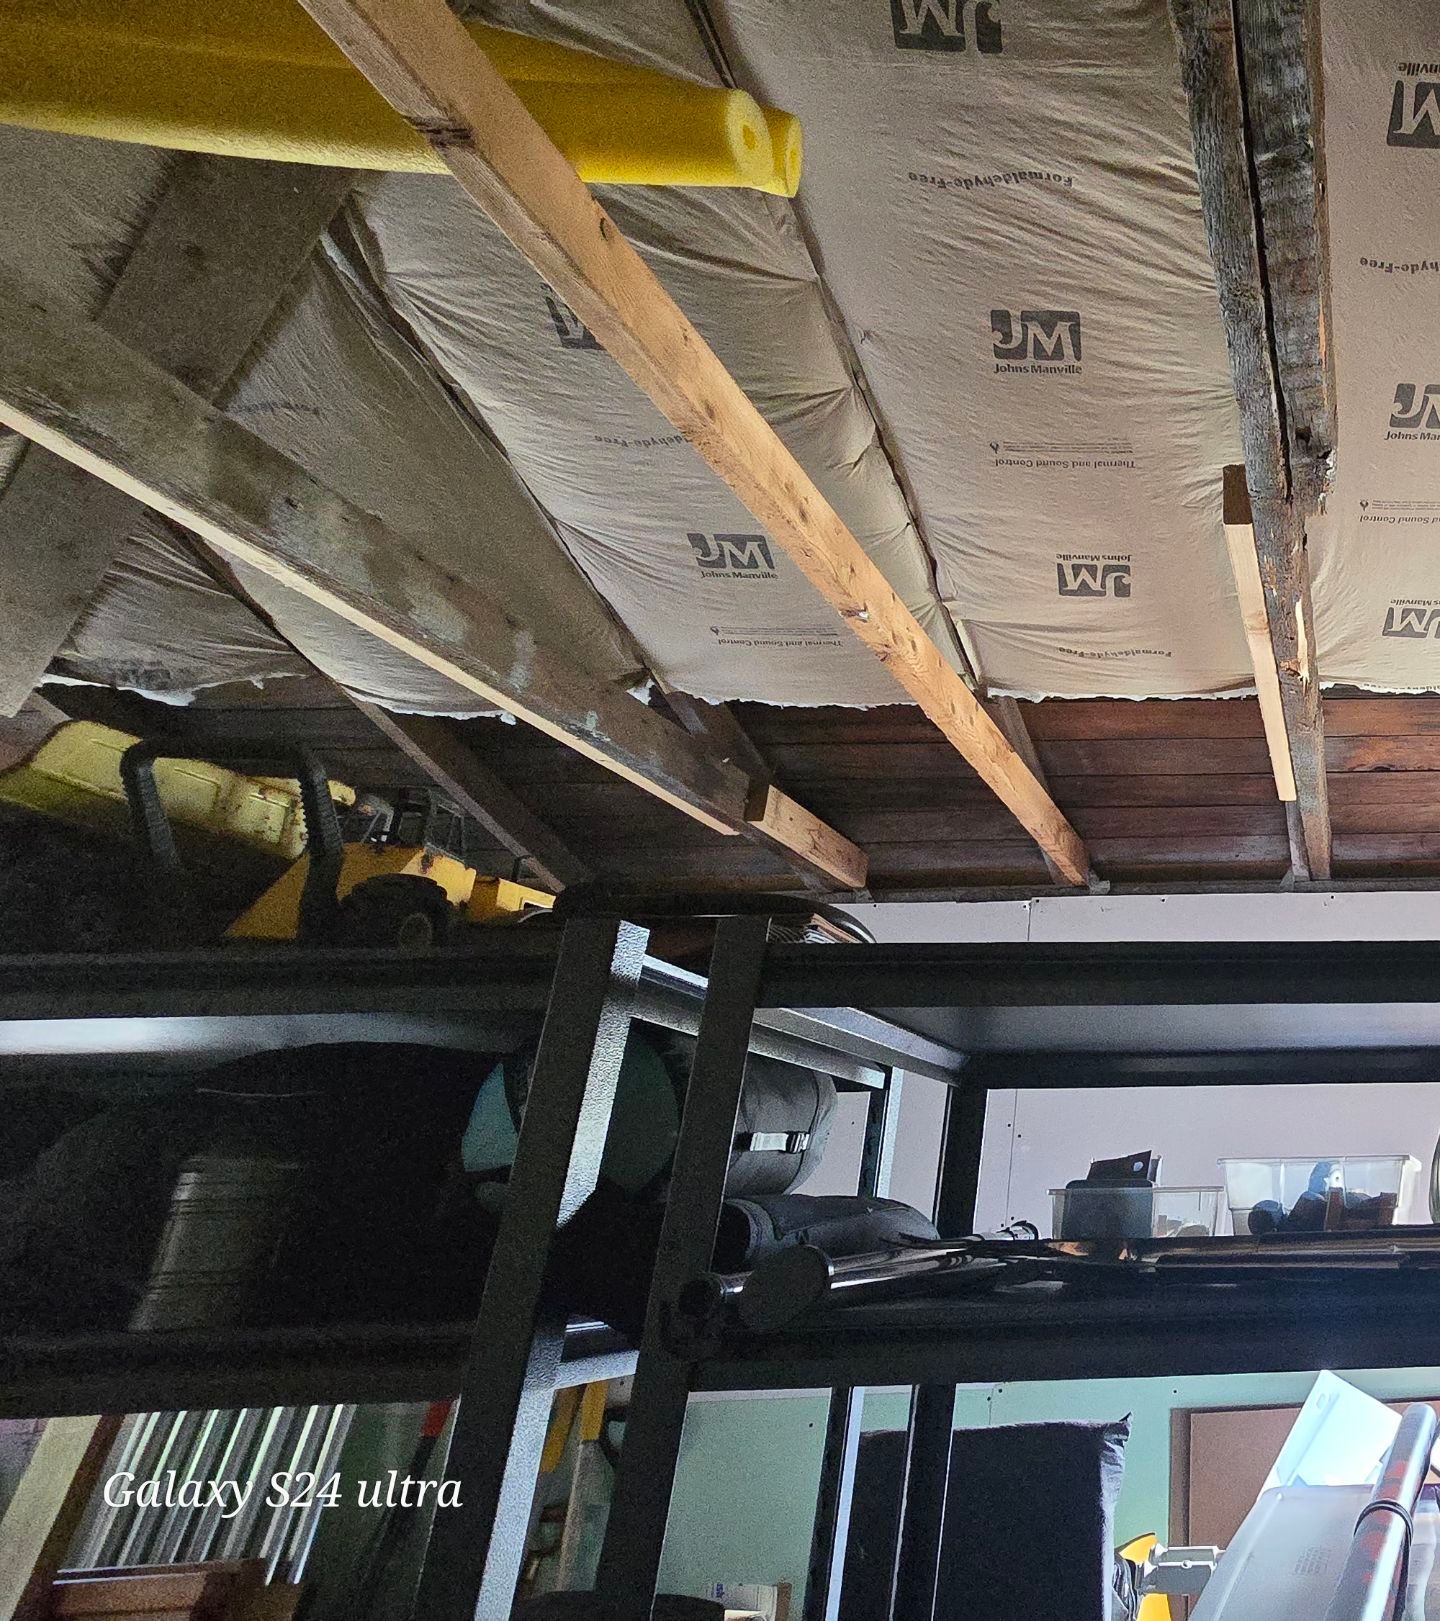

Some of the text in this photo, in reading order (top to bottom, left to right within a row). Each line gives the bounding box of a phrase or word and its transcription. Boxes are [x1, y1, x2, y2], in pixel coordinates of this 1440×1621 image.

[888, 0, 1003, 53] JM
[908, 171, 1073, 189] Formaldehyde-Free
[990, 309, 1082, 362] JM
[993, 363, 1083, 375] Johns Manville
[1384, 430, 1419, 442] Johns
[995, 458, 1136, 469] Thermal and Sound Control
[1359, 514, 1396, 525] Control
[1398, 516, 1430, 525] Sound
[686, 532, 774, 571] JM
[1055, 552, 1133, 563] Johns Manville
[700, 569, 778, 580] Johns Manville
[1056, 563, 1132, 598] JM
[1389, 598, 1433, 607] Manville
[717, 638, 844, 648] Thermal and Sound Control
[1057, 647, 1173, 659] Formaldehyde-Free
